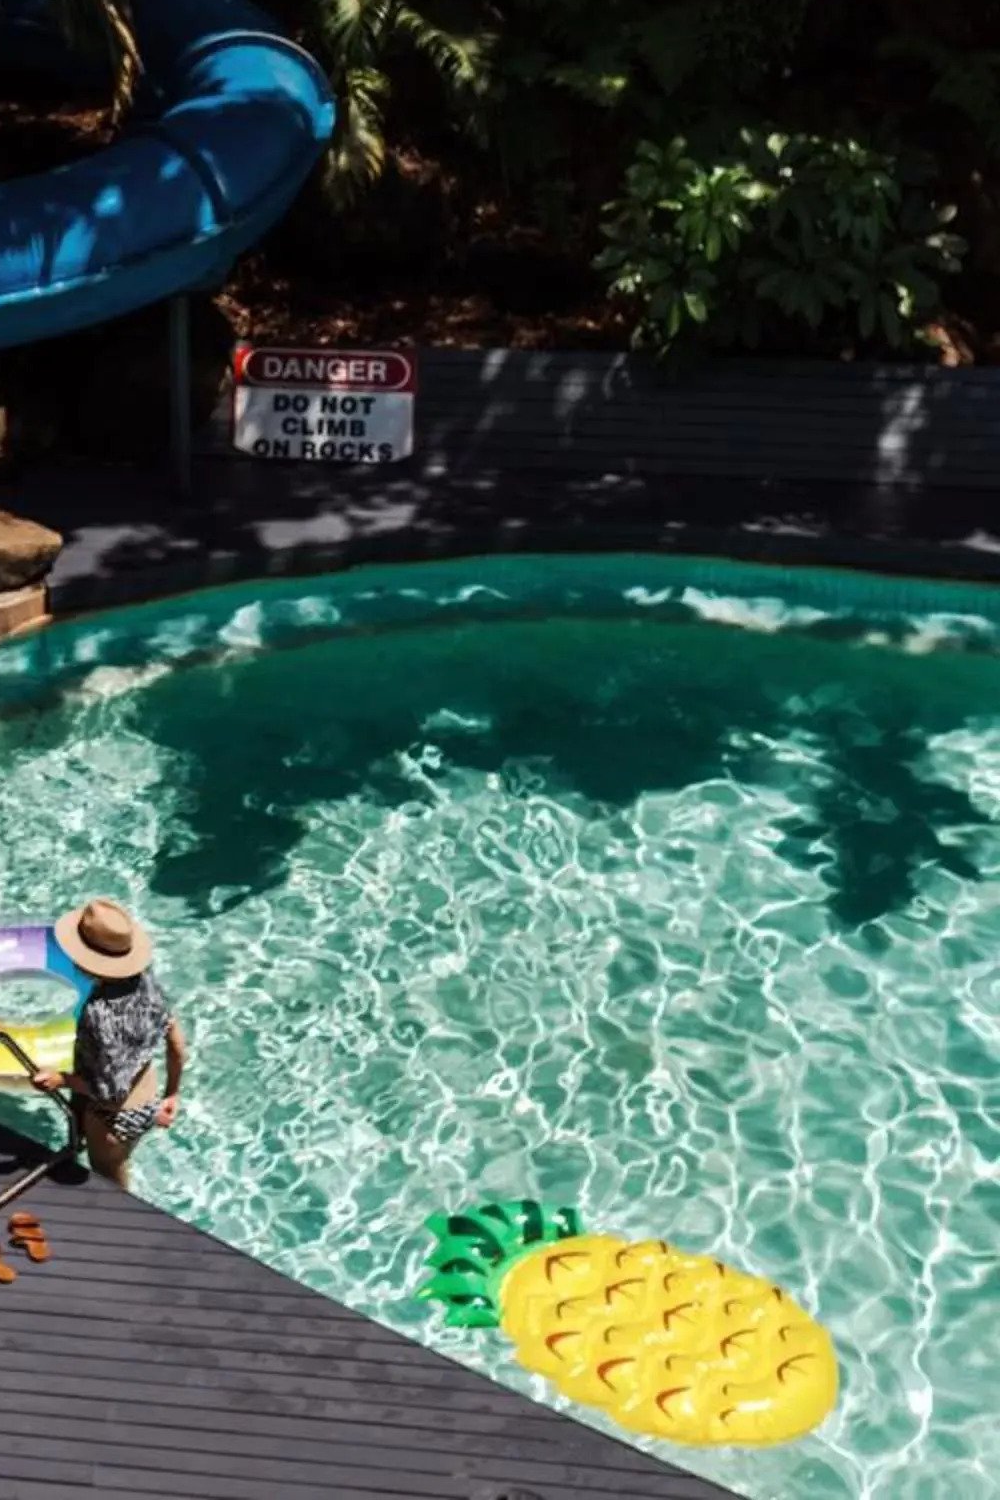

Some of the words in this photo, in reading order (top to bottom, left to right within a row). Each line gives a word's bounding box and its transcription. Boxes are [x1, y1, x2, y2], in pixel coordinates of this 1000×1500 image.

[263, 357, 388, 382] DANGER
[273, 394, 309, 413] DO
[320, 396, 376, 415] NOT
[281, 417, 366, 437] CLIMB
[253, 438, 290, 457] ON
[302, 440, 394, 461] ROCKS
